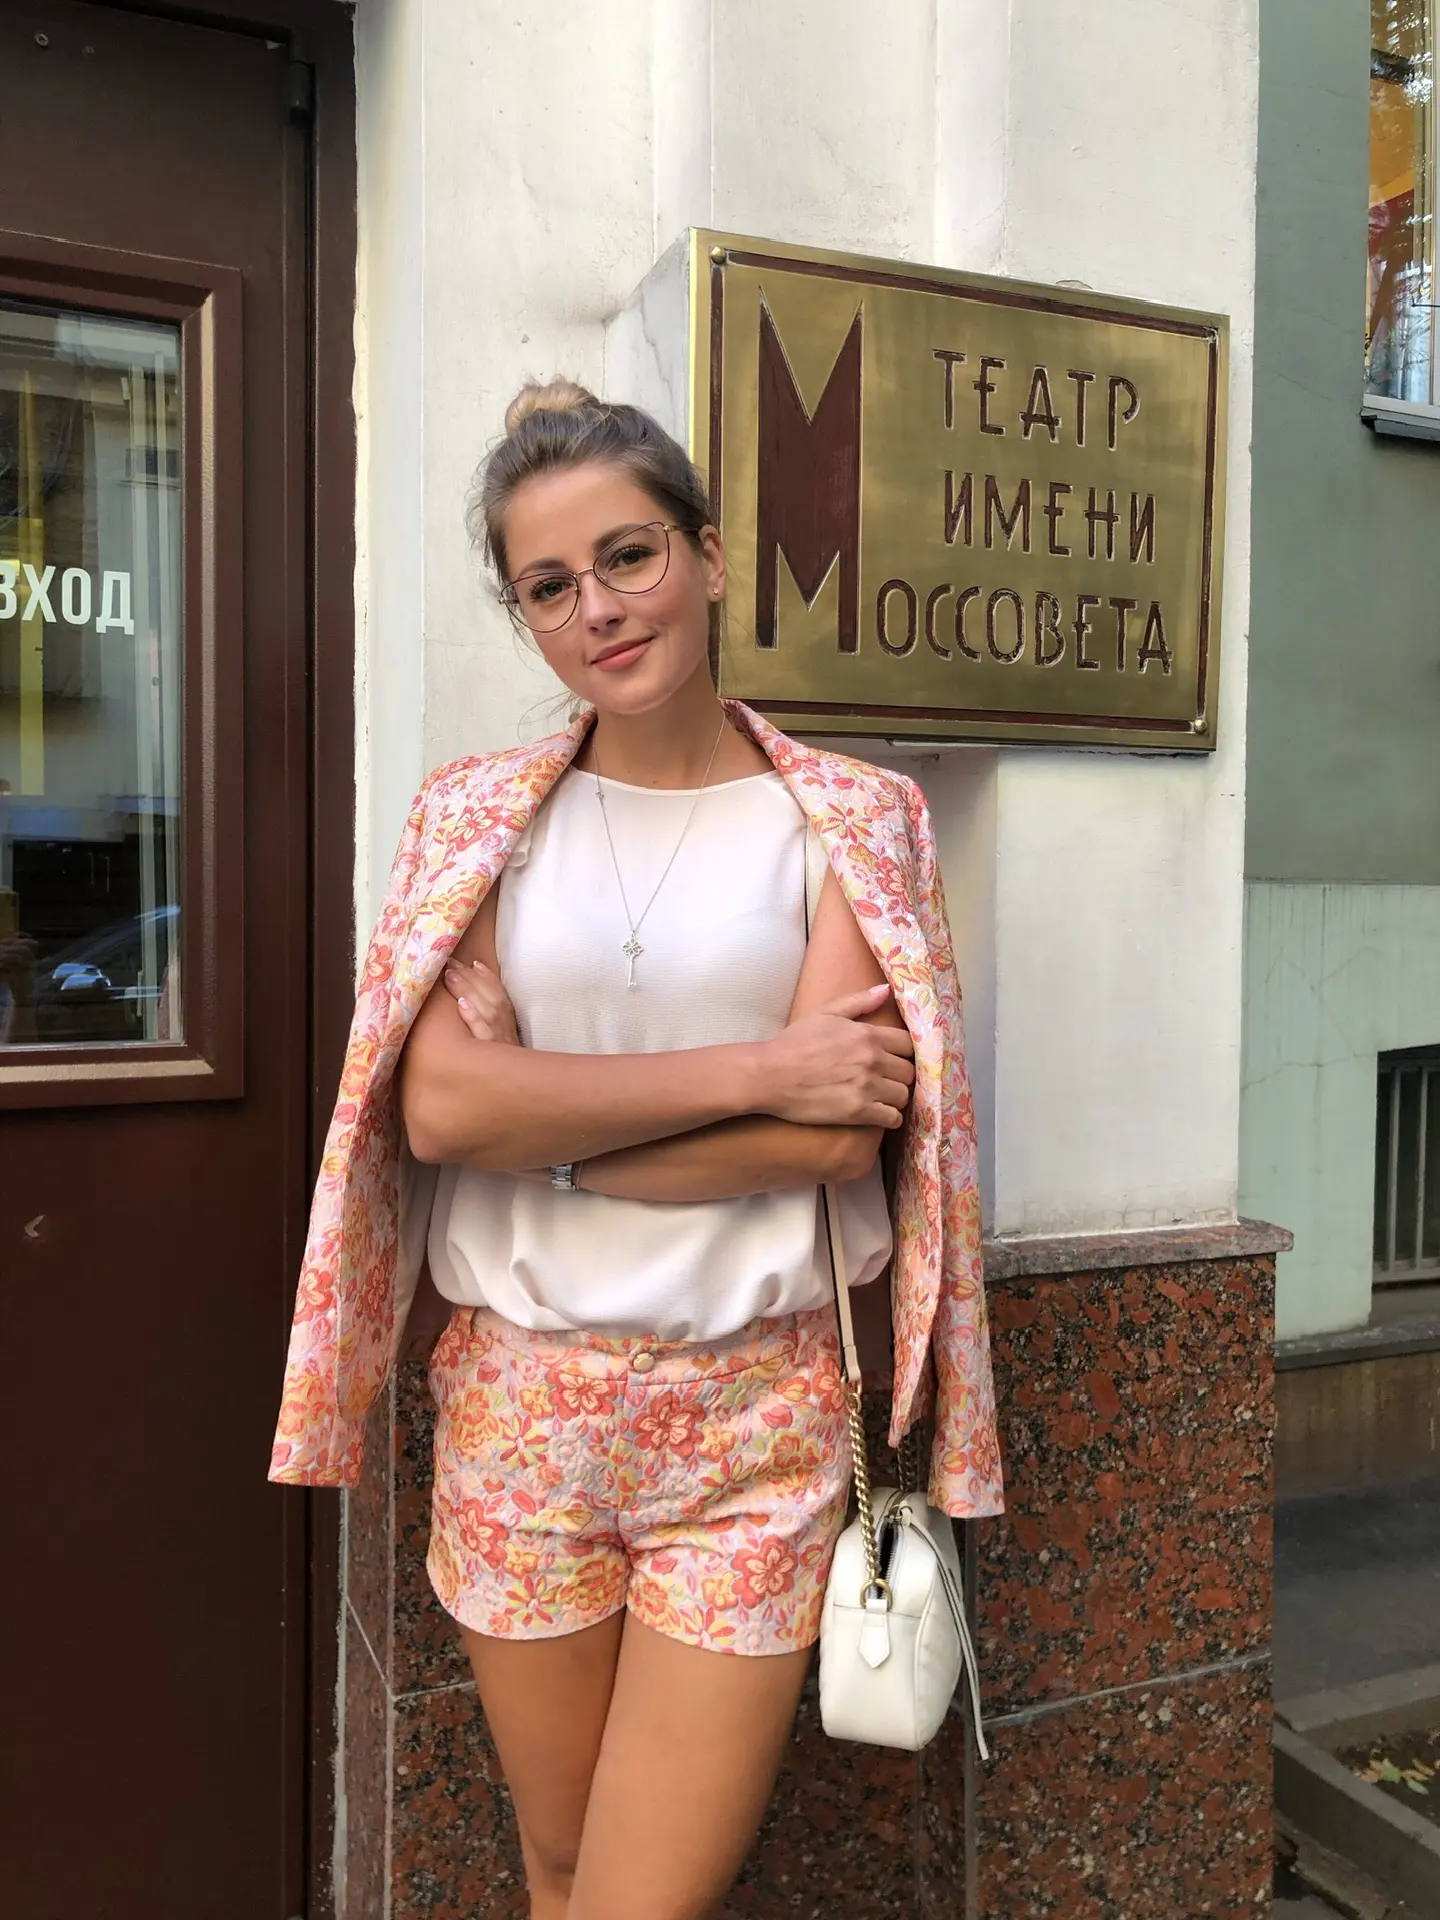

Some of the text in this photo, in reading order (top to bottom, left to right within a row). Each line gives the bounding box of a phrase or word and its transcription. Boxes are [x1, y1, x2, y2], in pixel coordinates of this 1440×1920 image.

[932, 348, 1142, 451] ТЕАТР
[944, 469, 1158, 566] ИМЕНИ
[0, 560, 135, 636] ВХОД
